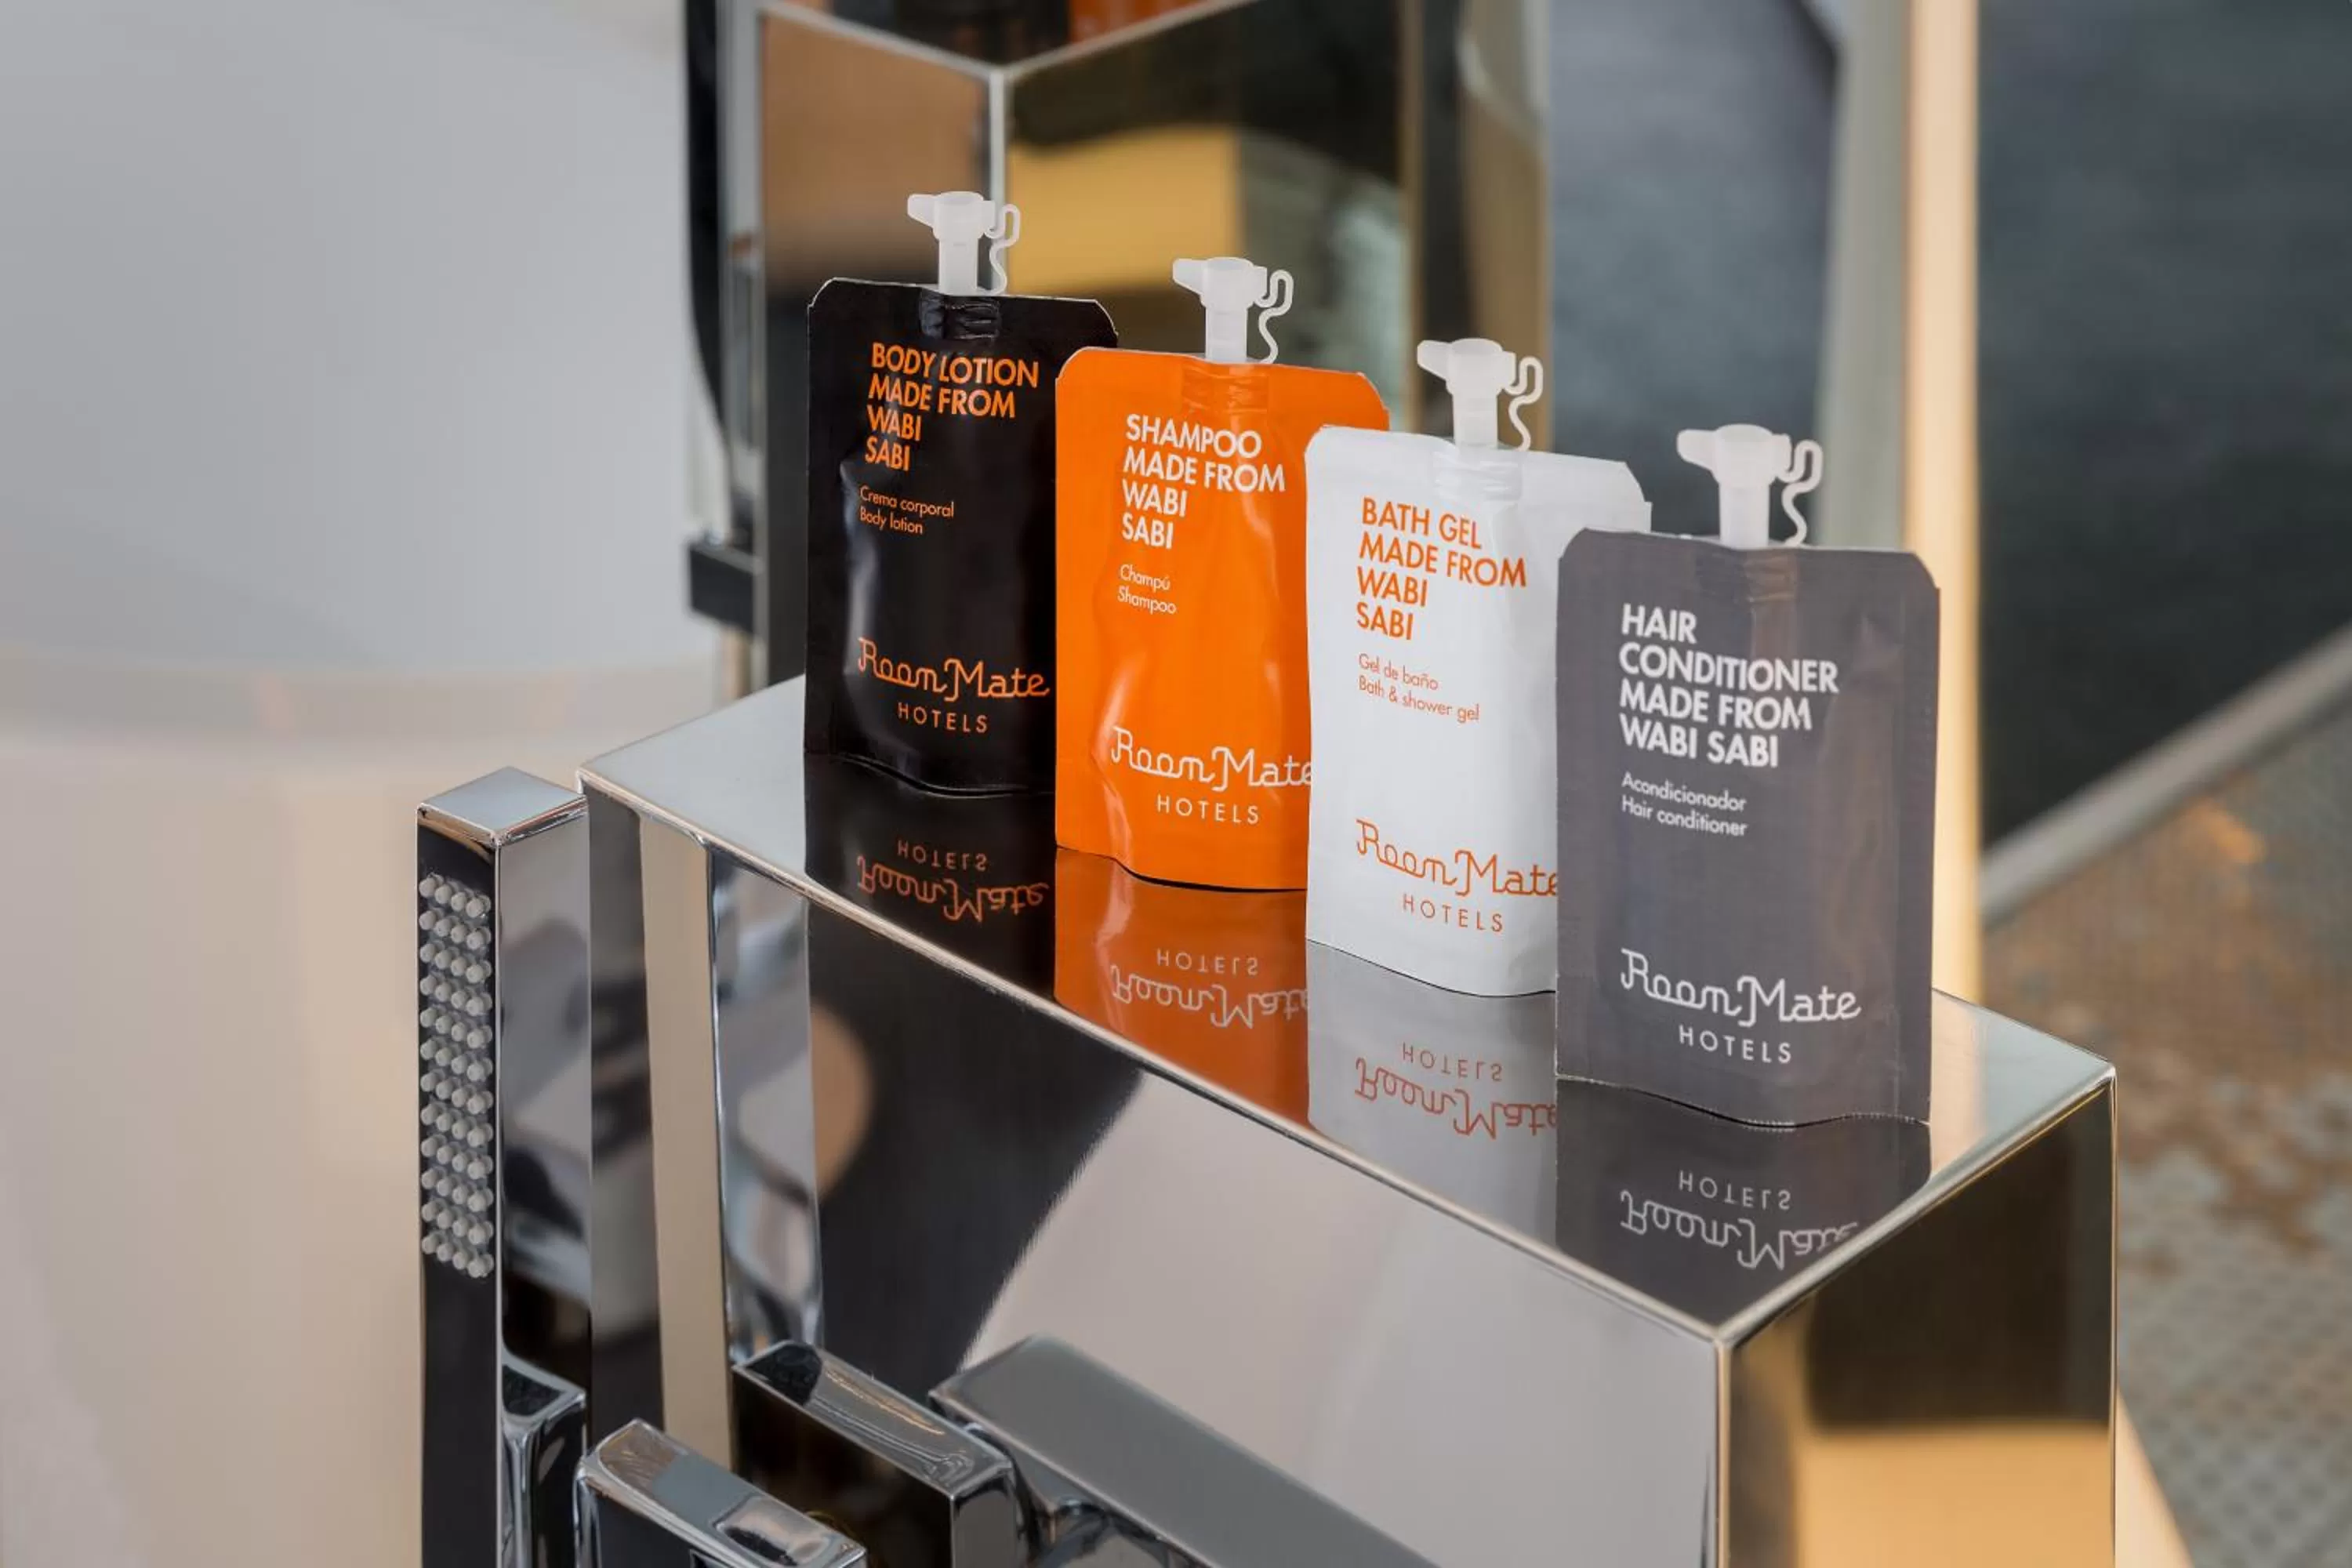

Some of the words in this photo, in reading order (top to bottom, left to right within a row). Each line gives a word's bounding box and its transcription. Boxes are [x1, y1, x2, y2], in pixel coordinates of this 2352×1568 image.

[872, 343, 936, 378] BODY
[939, 356, 1039, 388] LOTION
[868, 373, 932, 411] MADE
[938, 387, 1015, 418] FROM
[866, 405, 921, 441] WABI
[1126, 413, 1261, 458] SHAMPOO
[865, 435, 909, 471] SABI
[1123, 446, 1197, 485] MADE
[1204, 461, 1286, 493] FROM
[860, 485, 897, 509] Crema
[900, 499, 954, 517] corporal
[1123, 478, 1187, 517] WABI
[860, 506, 887, 531] Body
[890, 512, 923, 535] lotion
[1122, 512, 1174, 549] SABI
[1362, 497, 1430, 536] BATH
[1439, 514, 1482, 549] GEL
[1120, 564, 1171, 591] Champú
[1359, 531, 1439, 574] MADE
[1446, 550, 1526, 588] FROM
[1118, 585, 1176, 615] Shampoo
[1357, 565, 1428, 607] WABI
[1356, 602, 1414, 641] SABI
[1621, 603, 1697, 644] HAIR
[1359, 653, 1380, 673] Gel
[1384, 661, 1398, 681] de
[1403, 665, 1439, 691] baño
[1619, 642, 1839, 693] CONDITIONER
[898, 702, 988, 734] HOTELS
[1359, 675, 1384, 699] Bath
[1388, 687, 1397, 703] &
[1403, 690, 1452, 716] shower
[1457, 704, 1479, 724] gel
[1620, 677, 1709, 723] MADE
[1719, 694, 1812, 731] FROM
[1619, 713, 1697, 759] WABI
[1707, 731, 1778, 768] SABI
[1157, 793, 1259, 824] HOTELS
[1621, 771, 1747, 811] Acondicionador
[1621, 794, 1653, 818] Hair
[1657, 808, 1747, 837] conditioner
[1403, 893, 1503, 933] HOTELS
[1679, 1025, 1791, 1063] HOTELS
